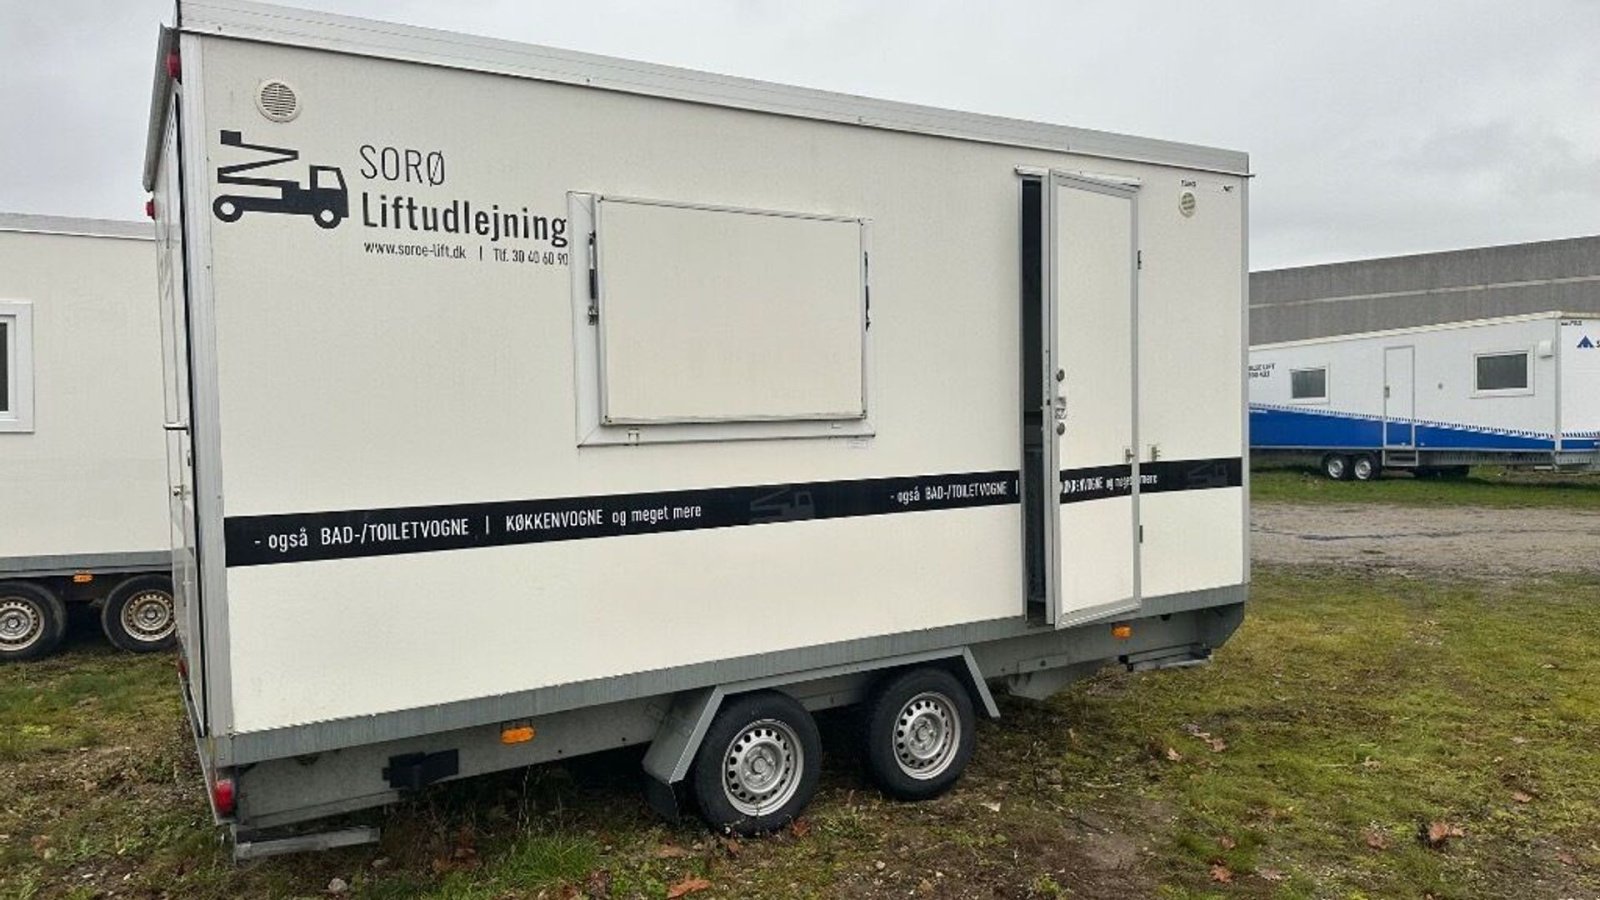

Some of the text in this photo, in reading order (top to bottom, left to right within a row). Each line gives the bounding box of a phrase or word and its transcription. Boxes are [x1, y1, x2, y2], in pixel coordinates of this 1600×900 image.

[358, 143, 446, 188] SORØ
[361, 191, 568, 247] Liftudlejning
[363, 241, 467, 260] www.soroe-lift.dk
[493, 247, 510, 262] Tlf.
[512, 249, 525, 263] 30
[527, 250, 541, 264] 40
[542, 251, 555, 266] 60
[557, 252, 569, 266] 90
[897, 487, 920, 505] også
[925, 481, 1007, 500] BAD-/TOILETVOGNE
[268, 526, 308, 552] også
[321, 518, 469, 545] BAD-/TOILETVOGNE
[505, 509, 603, 532] KØKKENVOGNE
[612, 510, 627, 527] og
[631, 506, 668, 525] meget
[673, 505, 702, 520] mere
